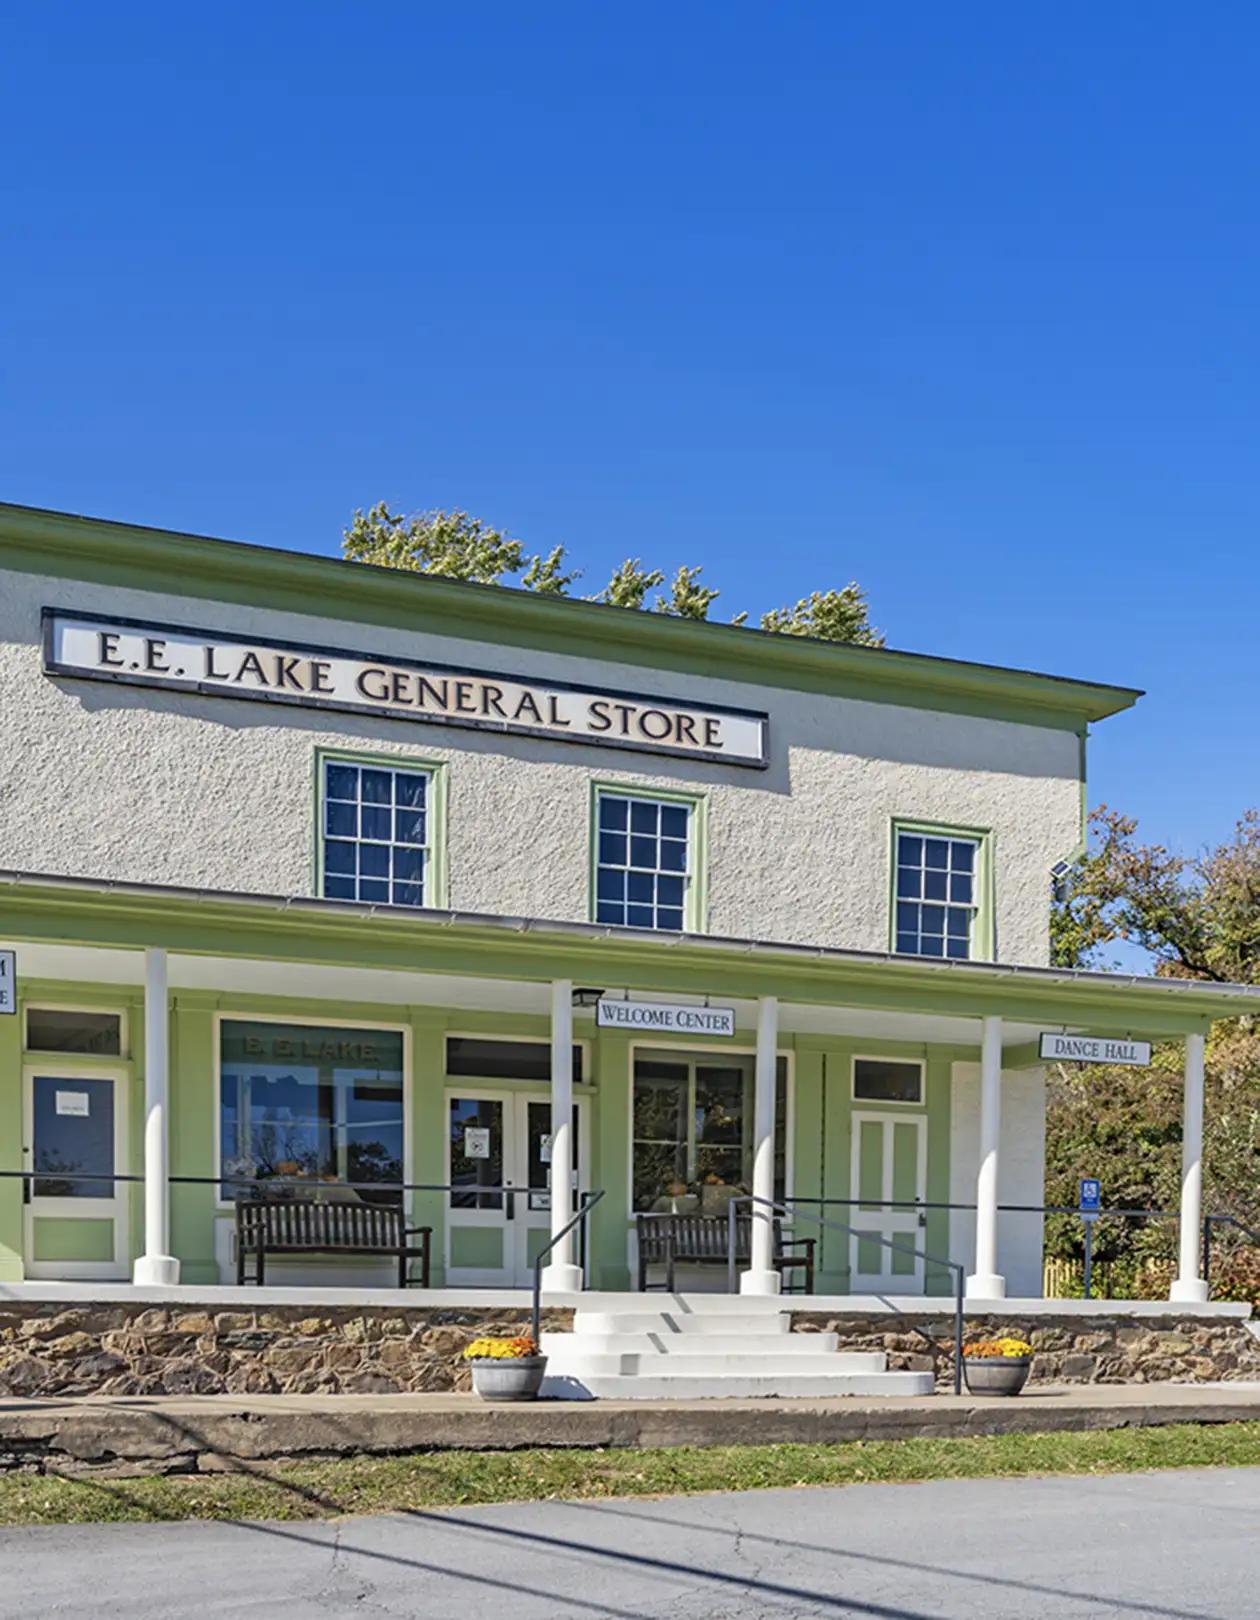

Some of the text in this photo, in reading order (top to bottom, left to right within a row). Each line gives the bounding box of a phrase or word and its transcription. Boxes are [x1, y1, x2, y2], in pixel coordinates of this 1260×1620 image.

[202, 646, 336, 694] LAKE
[356, 668, 571, 727] GENERAL
[587, 700, 724, 748] STORE
[602, 1004, 731, 1031] WELCOME CENTER
[1055, 1039, 1138, 1061] DANCE HALL
